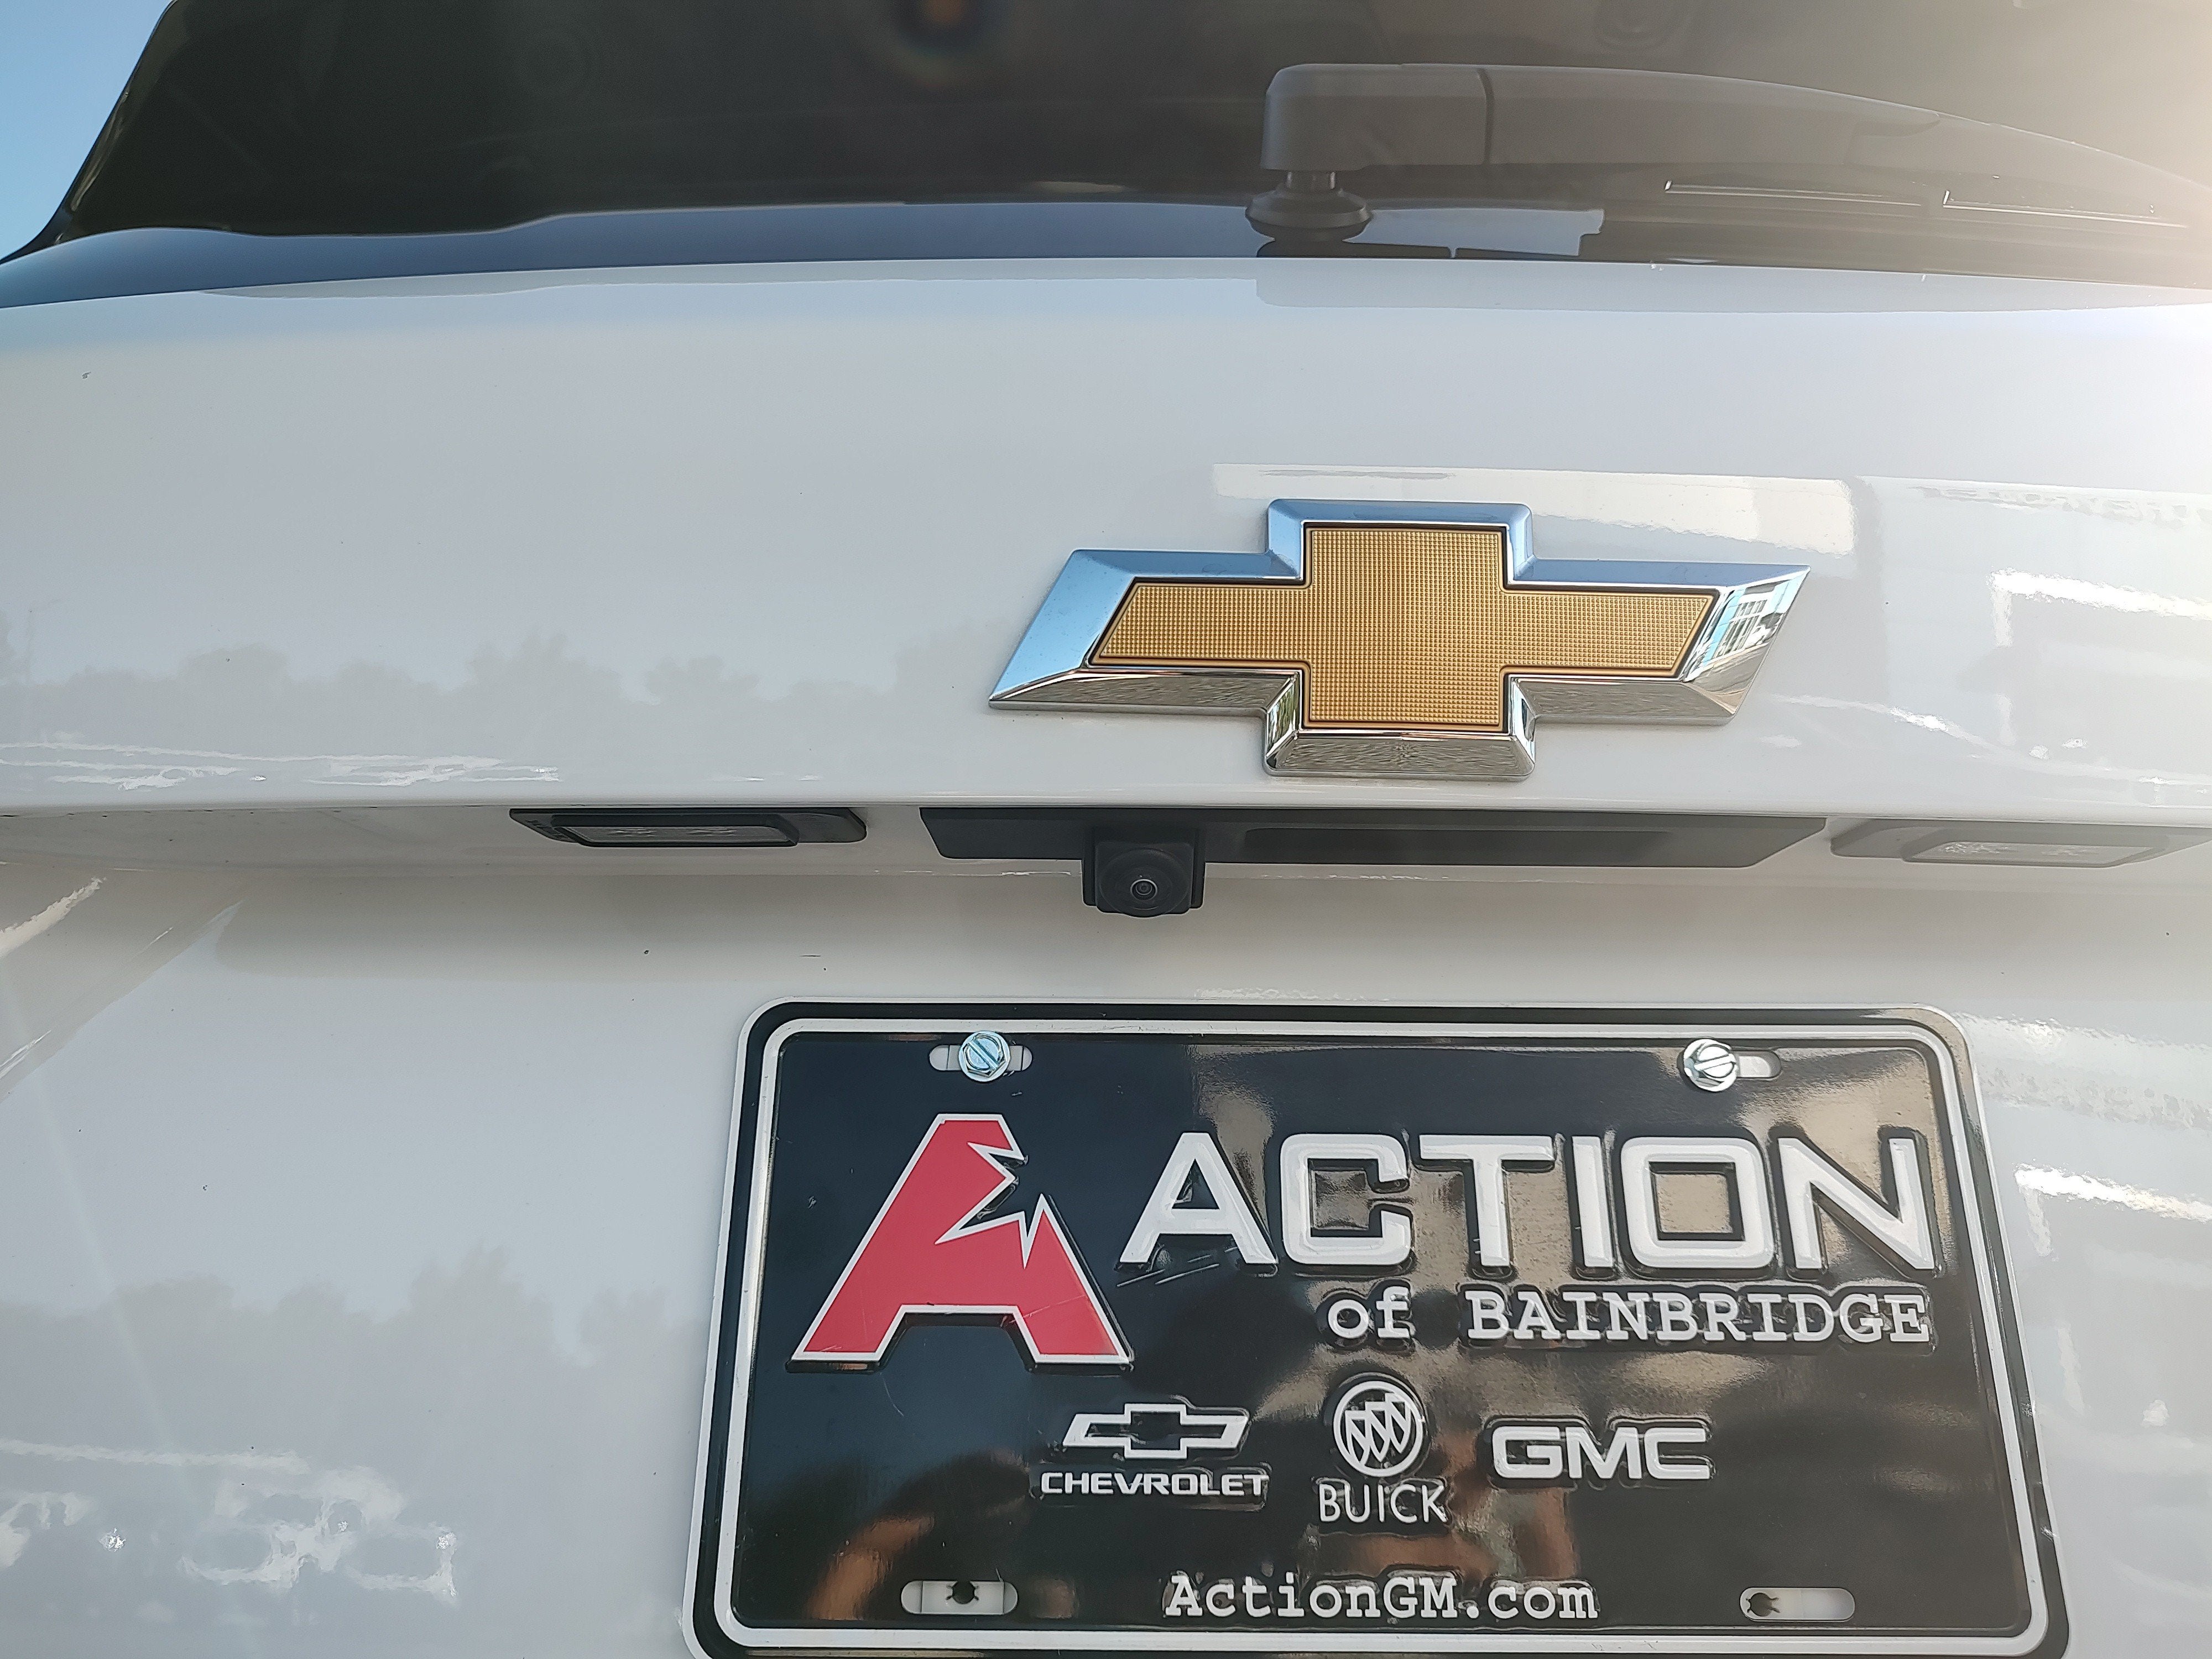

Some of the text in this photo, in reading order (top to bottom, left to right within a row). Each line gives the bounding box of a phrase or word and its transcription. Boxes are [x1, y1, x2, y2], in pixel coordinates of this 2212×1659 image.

[1118, 1131, 1938, 1270] ACTION
[1328, 1285, 1930, 1343] of BAINBRIDGE
[1491, 1426, 1711, 1480] GMC
[1040, 1472, 1269, 1496] CHEVROLET
[1318, 1484, 1449, 1524] BUICK
[1165, 1571, 1598, 1620] ActionGM.com
